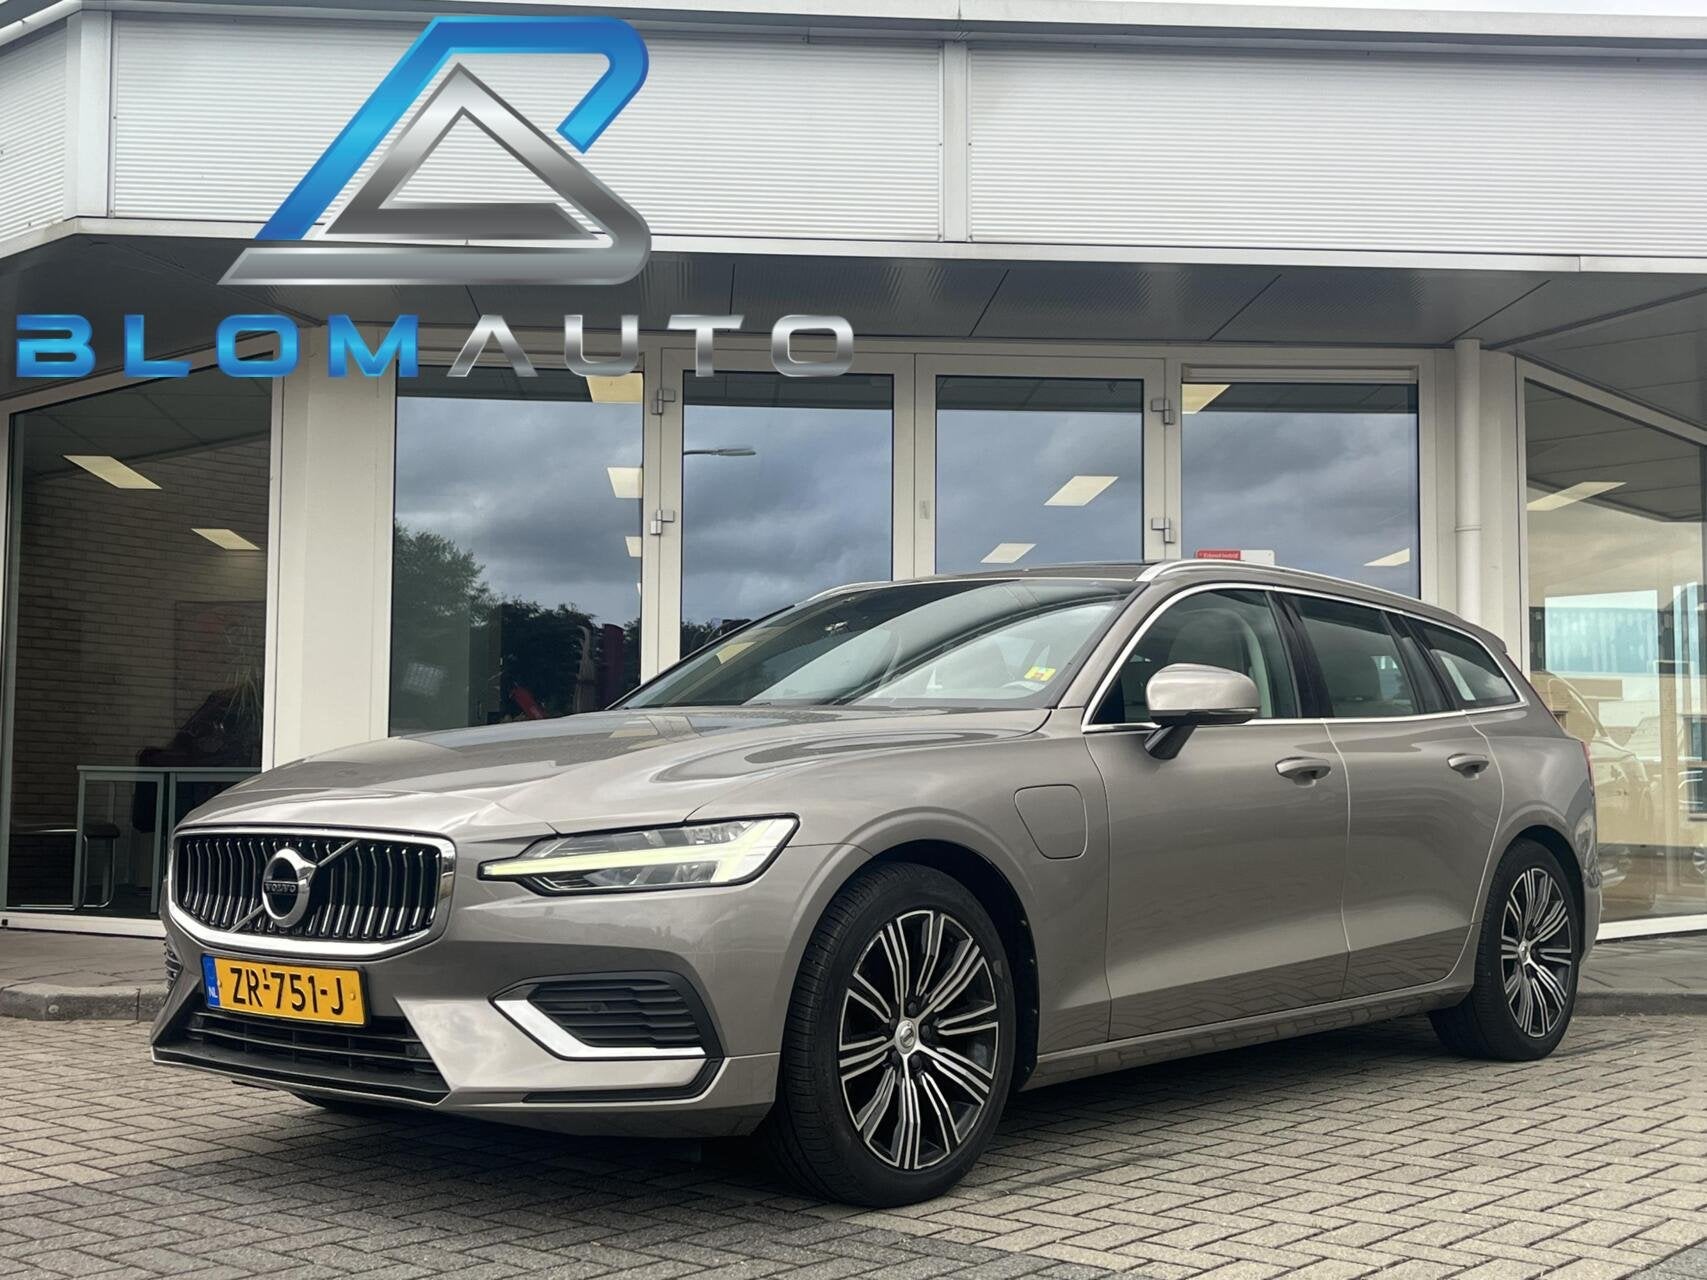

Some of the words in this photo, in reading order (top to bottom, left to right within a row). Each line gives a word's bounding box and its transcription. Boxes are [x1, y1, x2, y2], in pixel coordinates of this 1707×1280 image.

[264, 883, 297, 893] VOLVO
[208, 986, 218, 998] NL
[229, 967, 345, 1016] ZR-751-J
